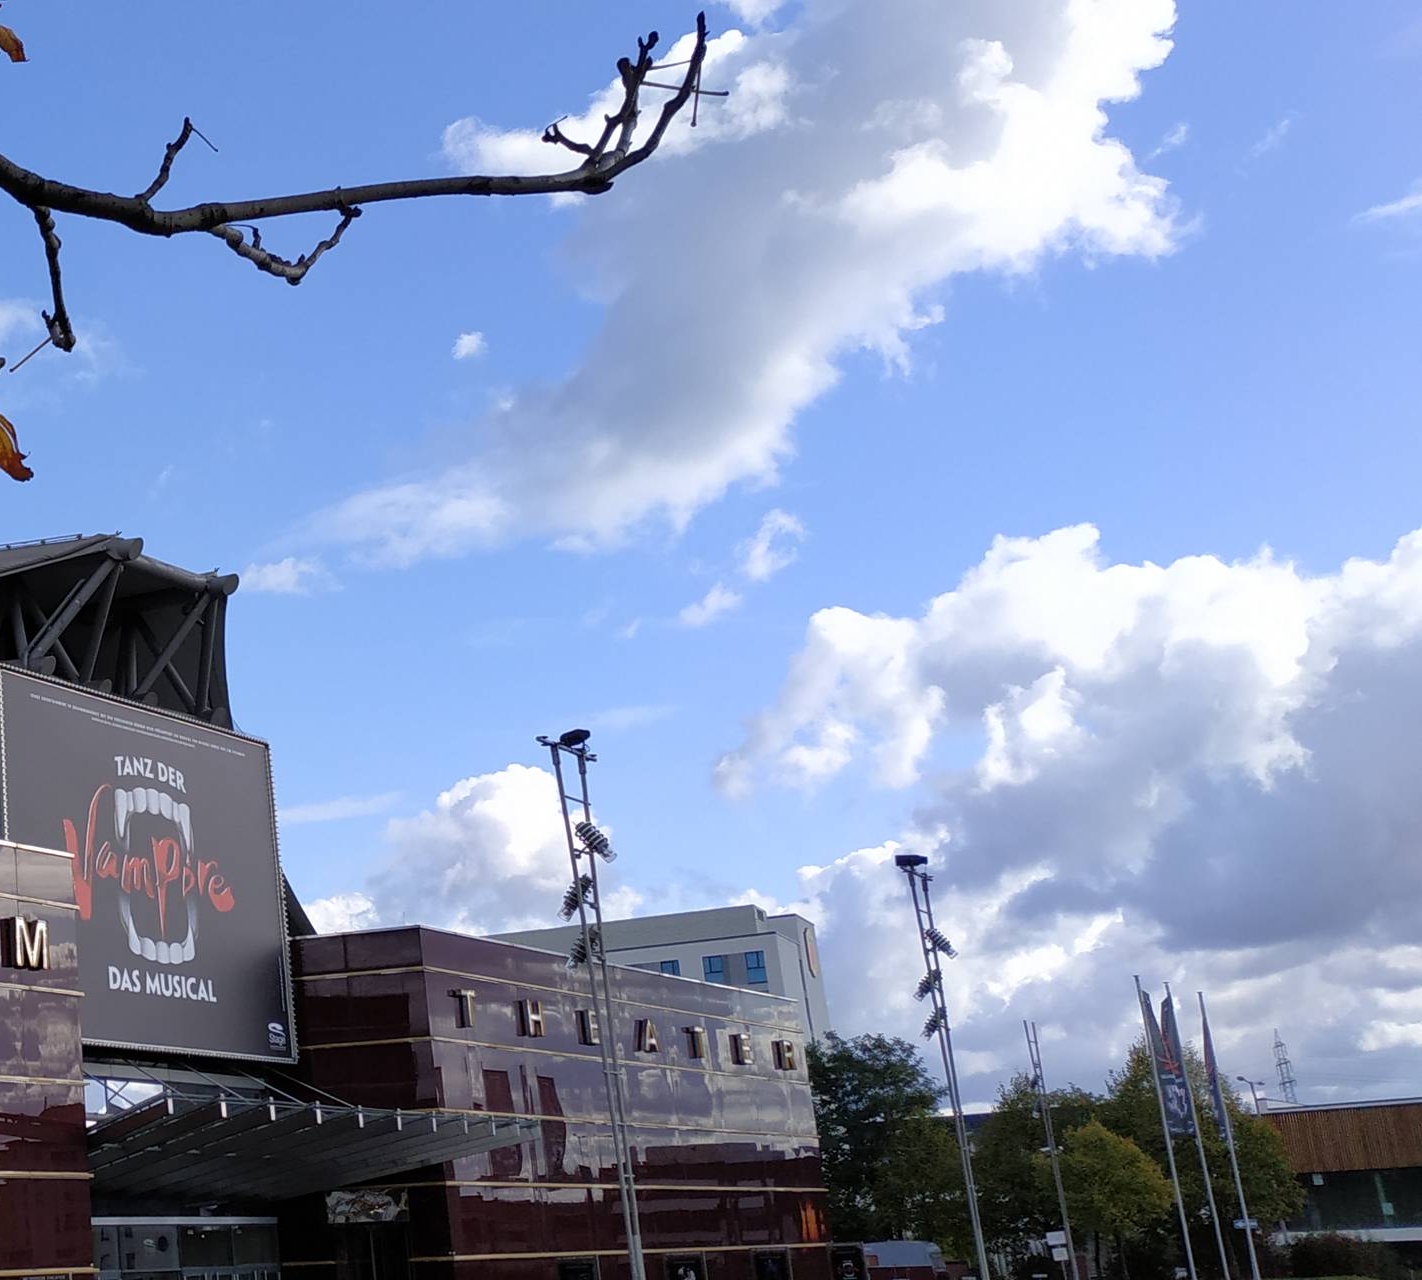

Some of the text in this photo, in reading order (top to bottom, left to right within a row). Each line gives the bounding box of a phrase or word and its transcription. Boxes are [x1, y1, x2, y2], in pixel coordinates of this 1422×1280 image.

[114, 755, 186, 793] TANZ DER
[62, 782, 235, 940] Vampire
[108, 966, 217, 1003] DAS MUSICAL
[448, 988, 798, 1071] THEATER
